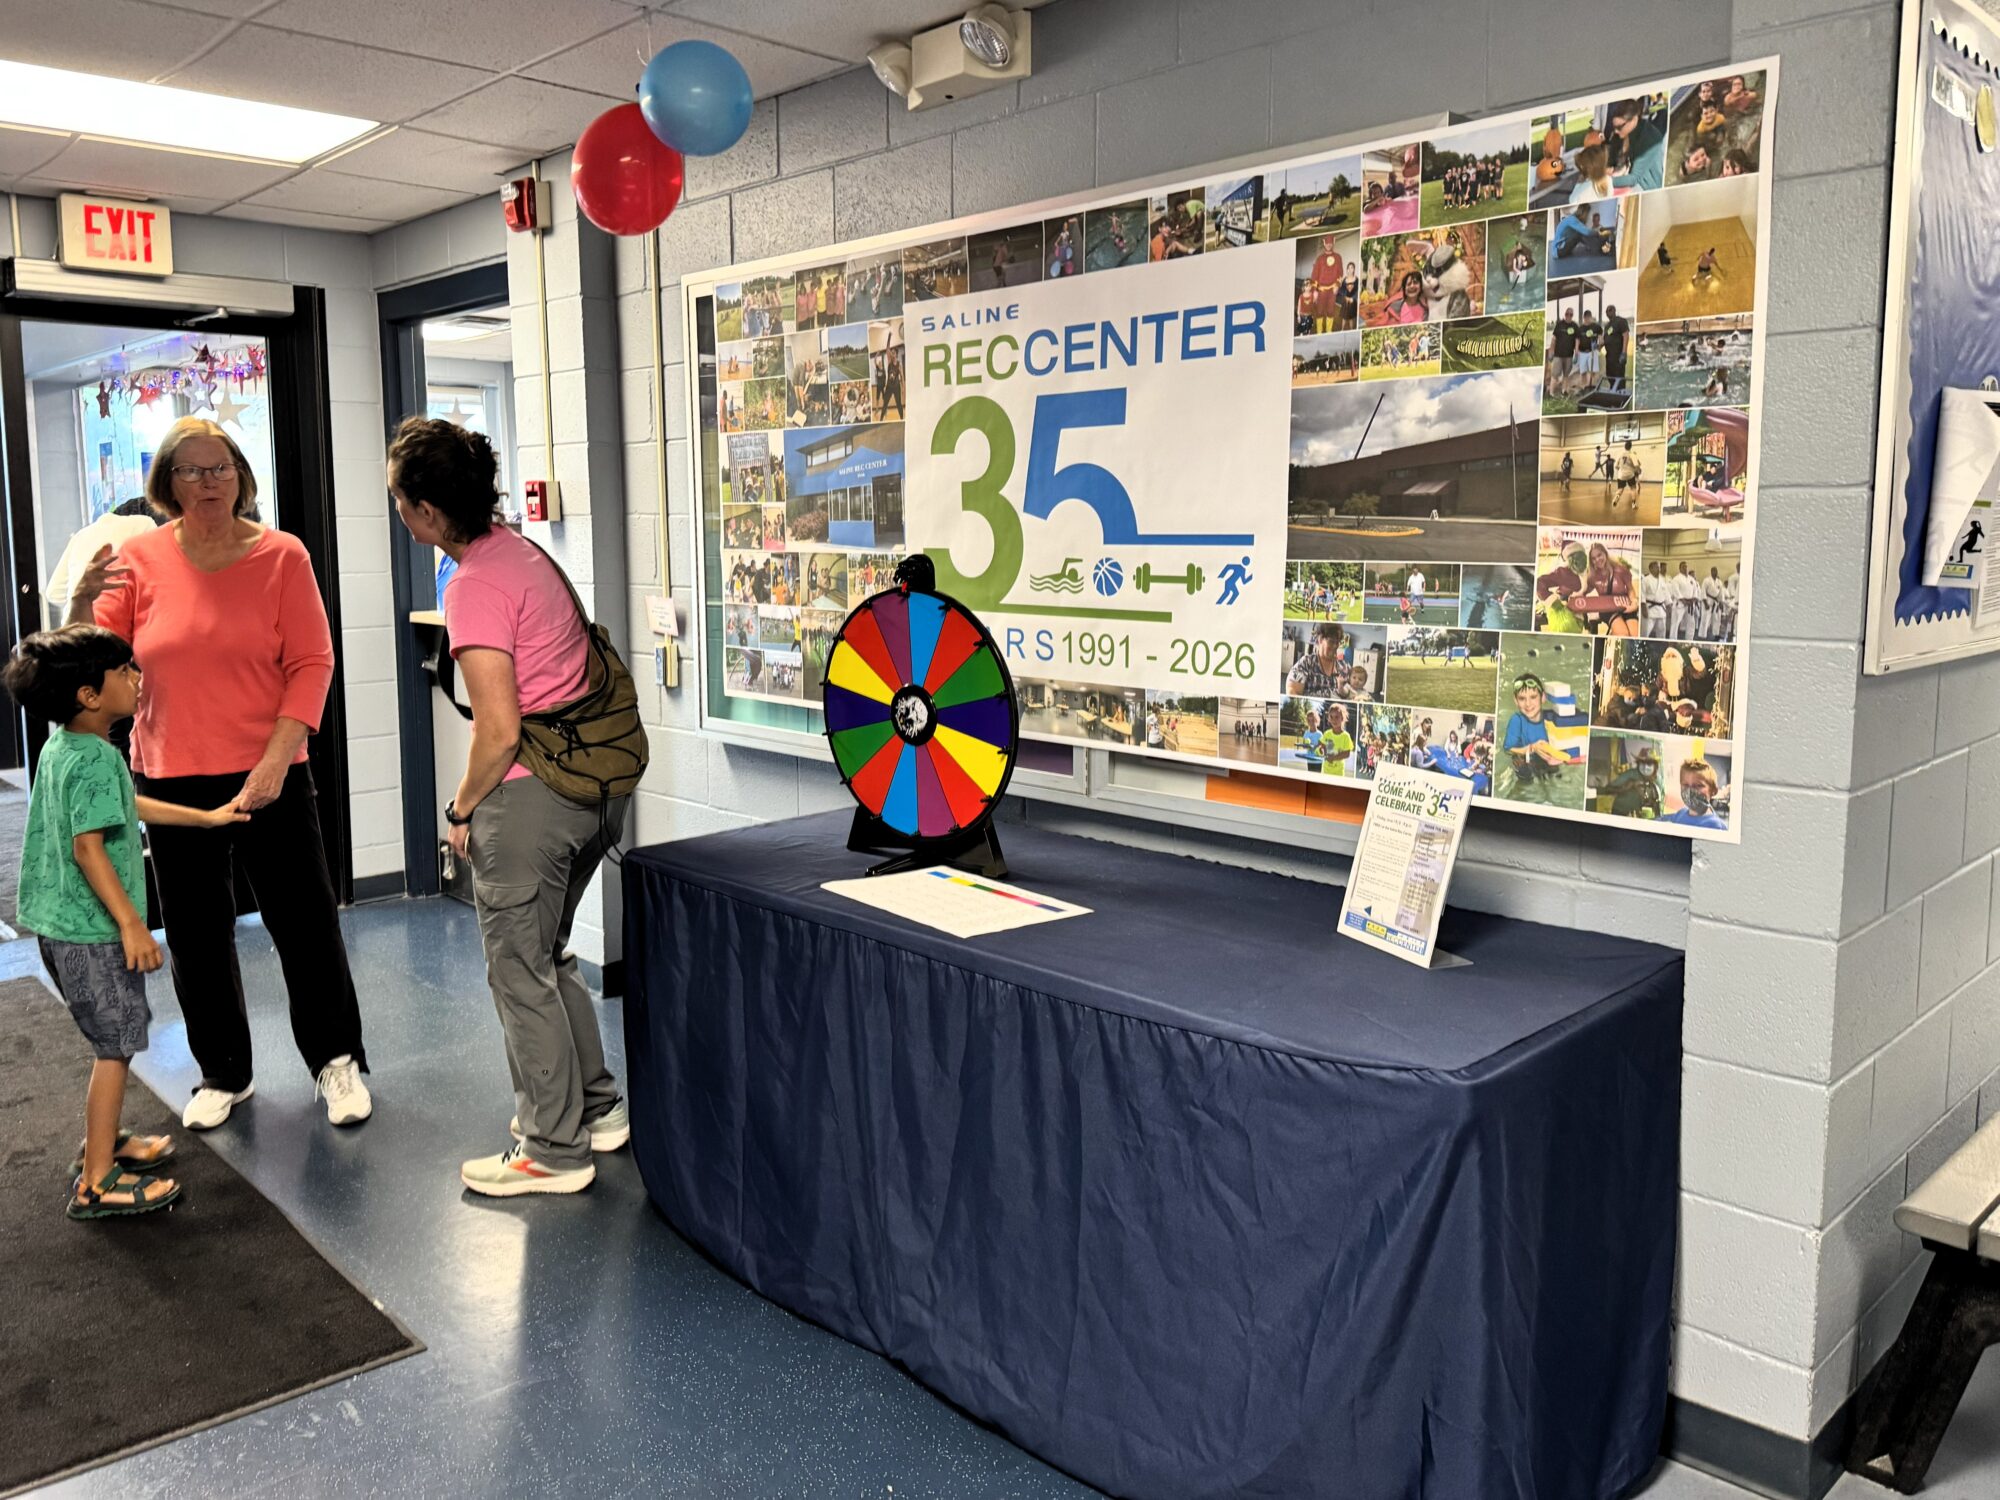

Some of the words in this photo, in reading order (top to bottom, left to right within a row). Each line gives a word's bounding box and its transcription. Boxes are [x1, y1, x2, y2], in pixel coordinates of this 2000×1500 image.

[84, 204, 155, 262] EXIT
[921, 303, 1020, 332] SALINE
[923, 387, 1138, 612] 35
[1062, 631, 1131, 669] 1991
[1169, 638, 1256, 680] 2026
[1375, 794, 1423, 816] CELEBRATE
[1378, 782, 1404, 798] COME
[1405, 790, 1426, 803] AND
[1426, 793, 1452, 816] 35
